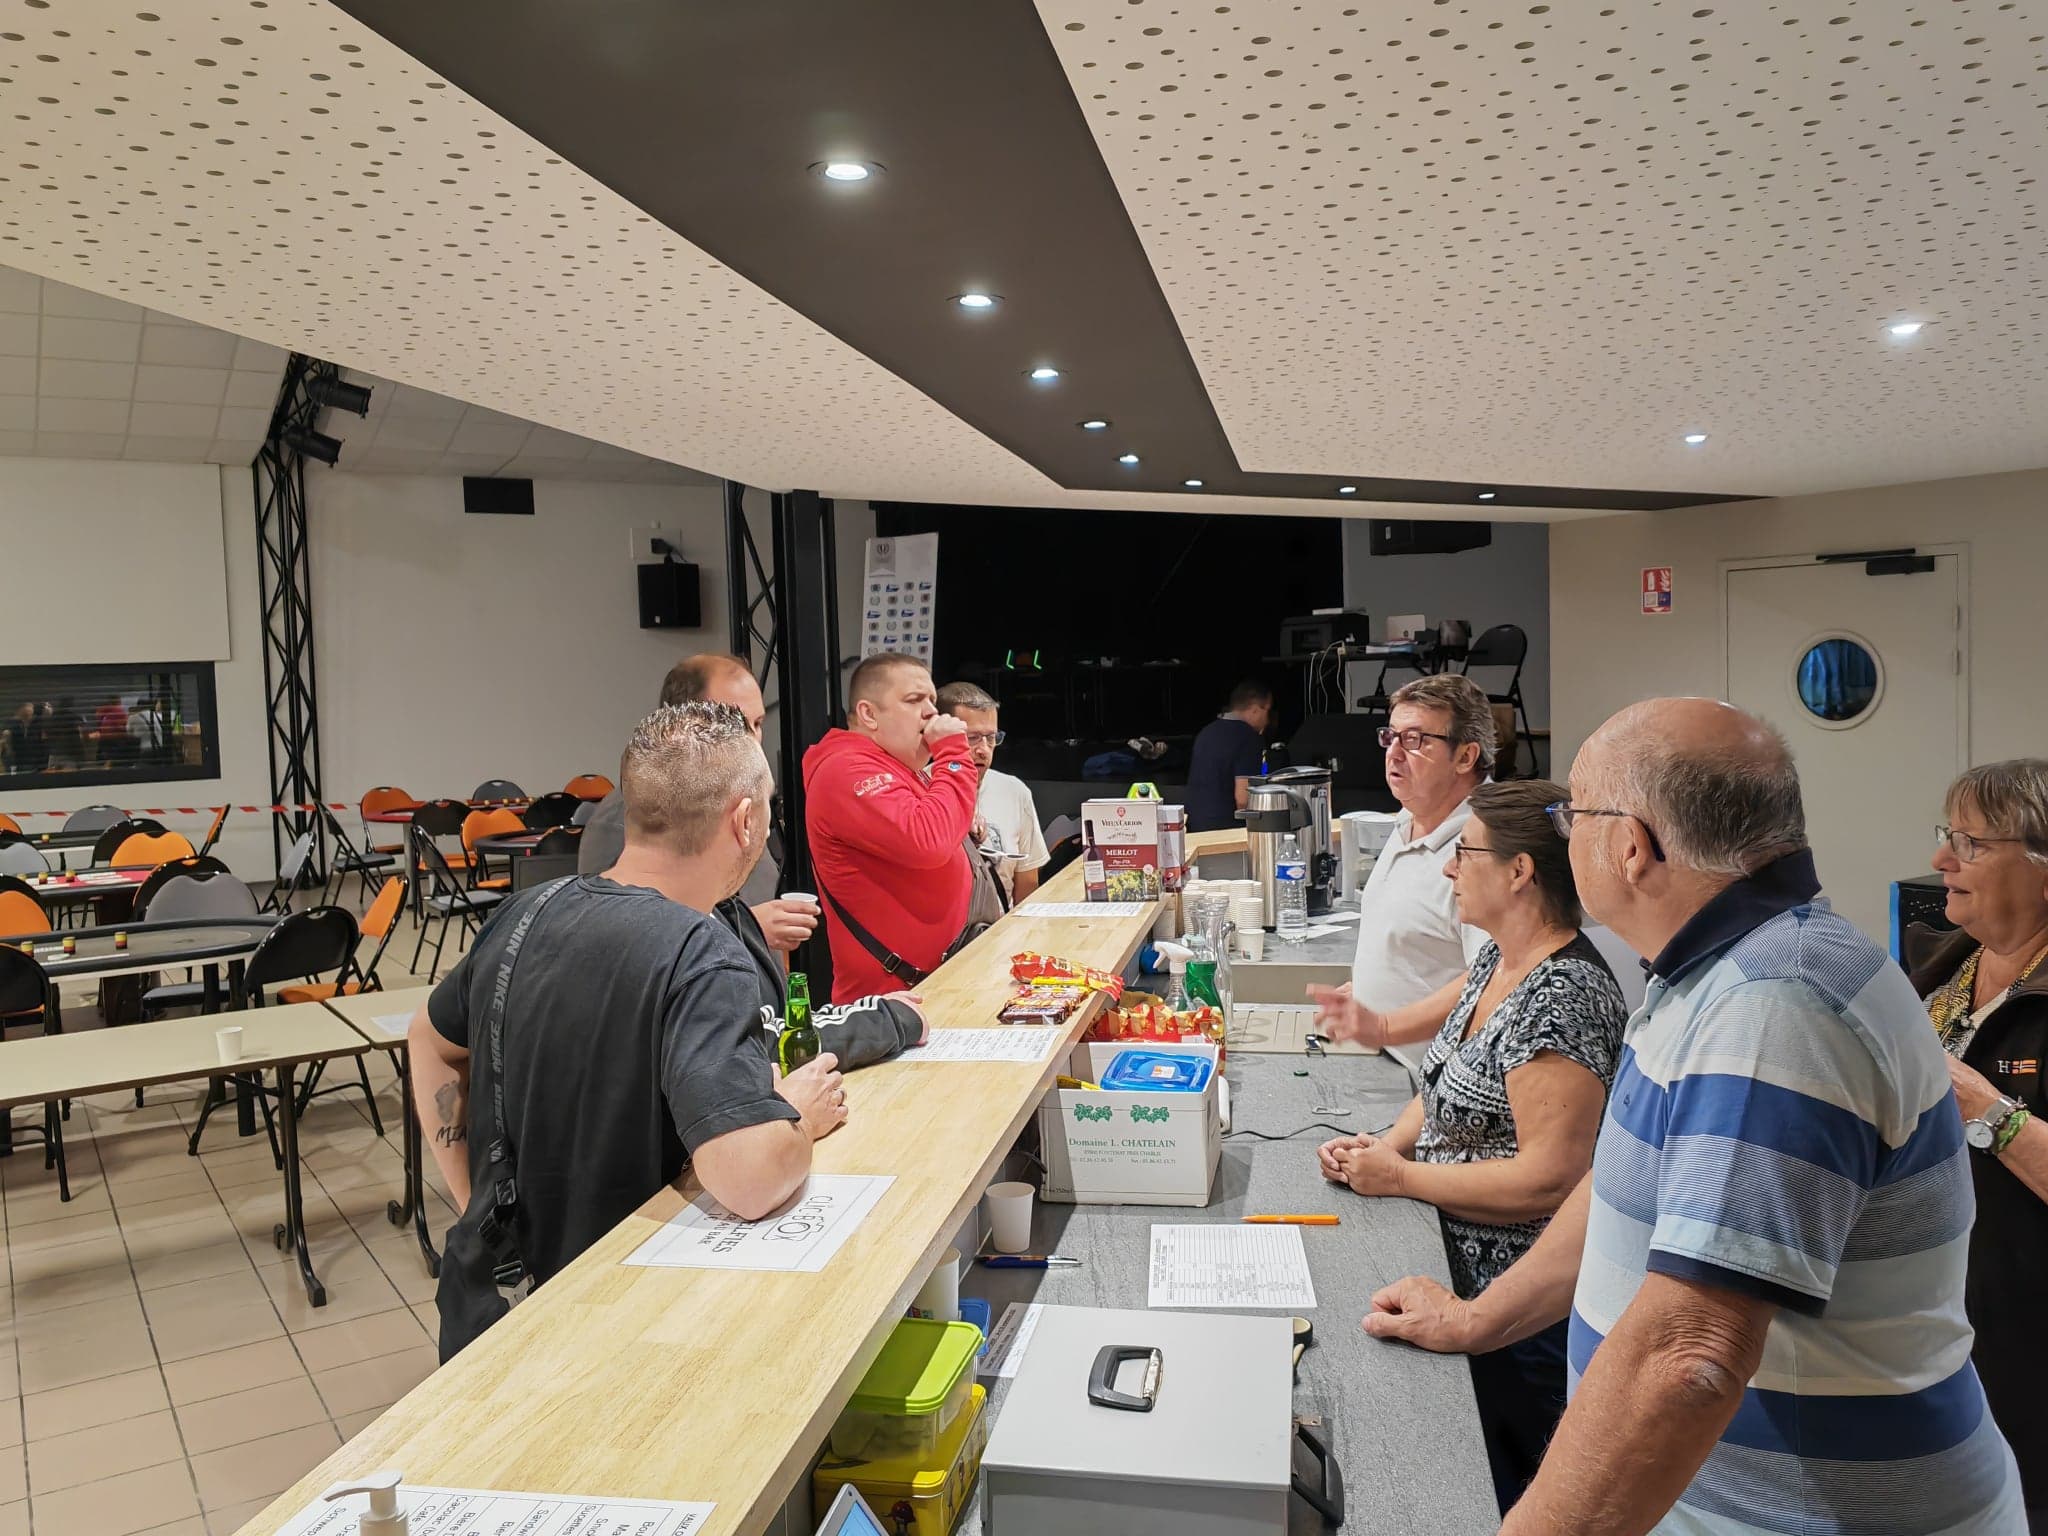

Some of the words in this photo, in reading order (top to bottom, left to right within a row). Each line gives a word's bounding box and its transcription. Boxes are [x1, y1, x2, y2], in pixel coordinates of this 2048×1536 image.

[505, 911, 534, 956] NIKE
[492, 962, 513, 1013] NIKE
[1998, 1060, 2010, 1074] H
[1069, 1137, 1108, 1147] Domaine
[1121, 1138, 1176, 1148] CHATELAIN
[712, 1221, 758, 1253] ELFIES
[301, 1507, 347, 1536] Schwep
[431, 1496, 468, 1525] Cacolac
[561, 1505, 597, 1536] Sucettes
[682, 1513, 697, 1530] VAUX
